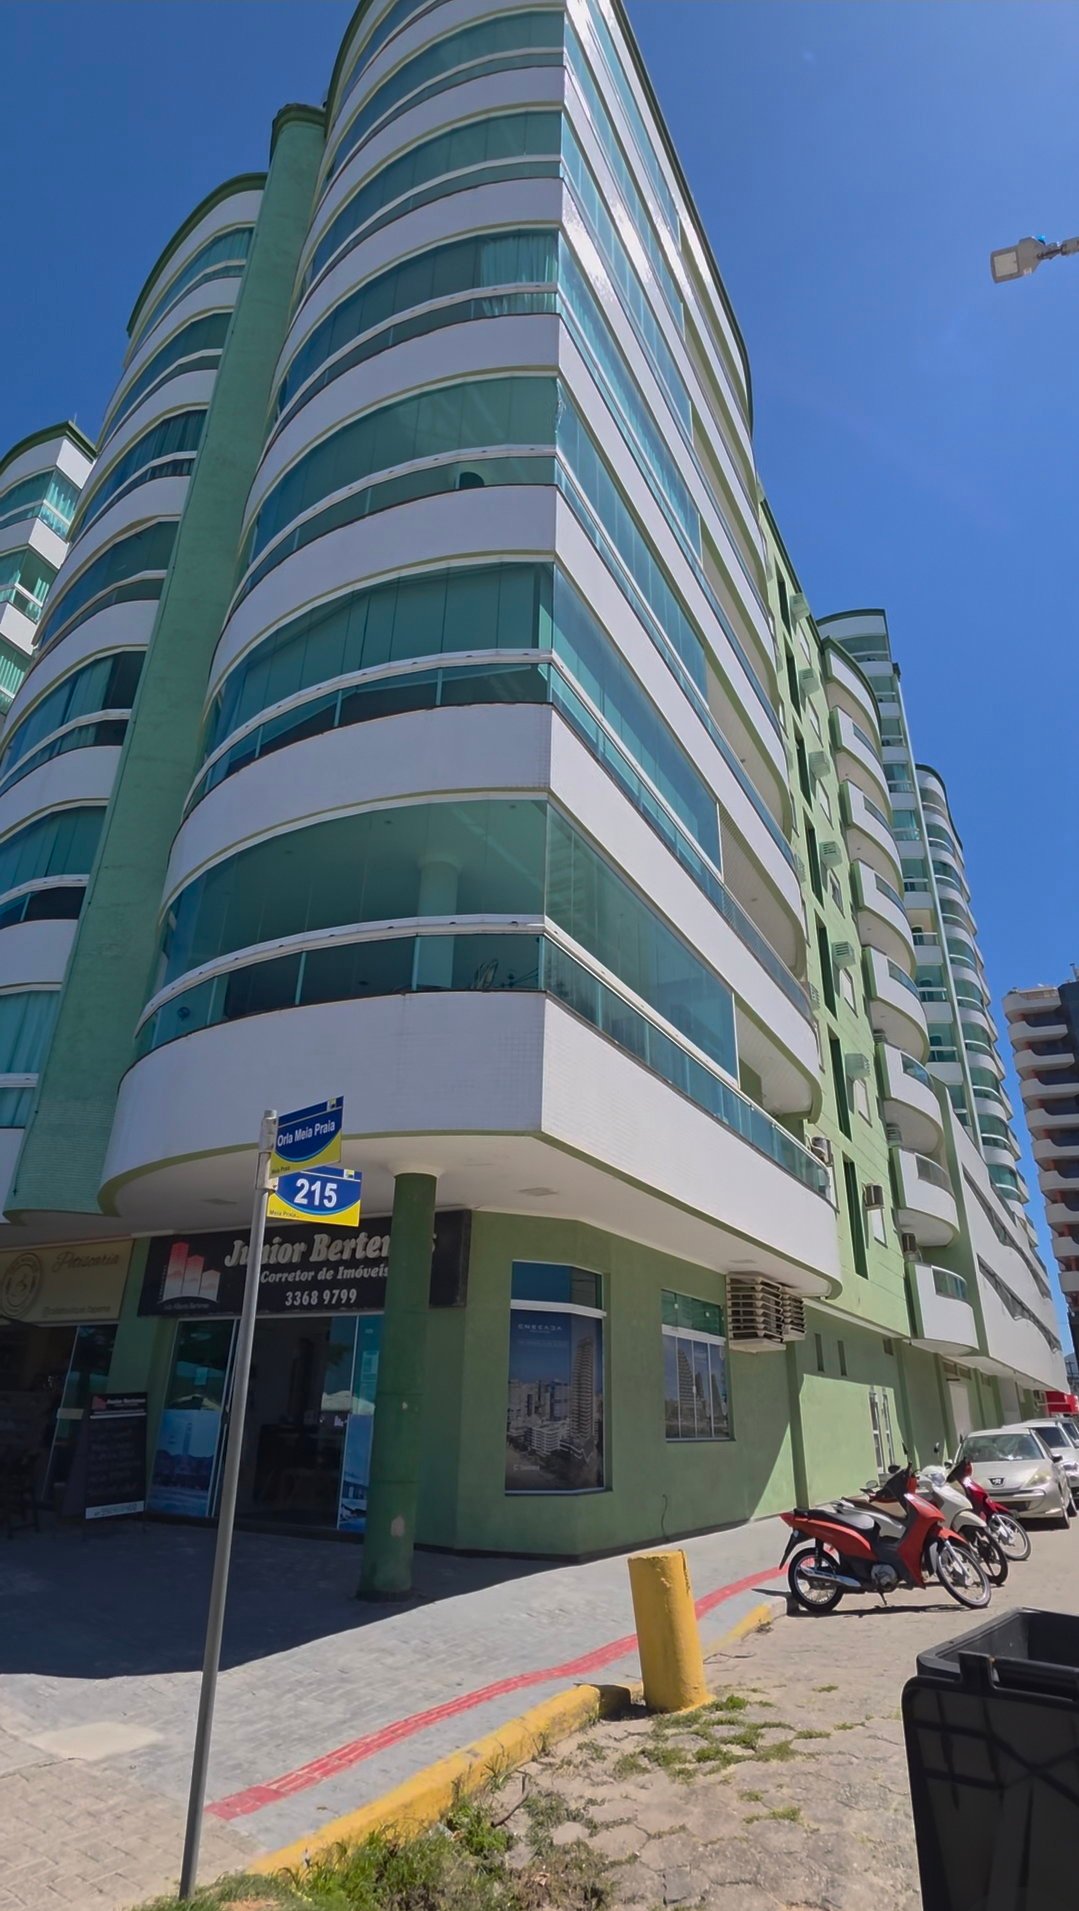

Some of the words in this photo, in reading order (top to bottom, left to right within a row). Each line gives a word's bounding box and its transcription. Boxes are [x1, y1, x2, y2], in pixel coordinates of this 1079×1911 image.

[277, 1134, 293, 1147] Orla
[294, 1128, 313, 1141] Meia
[314, 1120, 335, 1136] Praia
[294, 1178, 337, 1208] 215
[261, 1269, 315, 1284] Corretor
[317, 1267, 335, 1281] de
[336, 1263, 389, 1280] Imóveis
[285, 1289, 319, 1306] 3368
[322, 1288, 357, 1305] 9799
